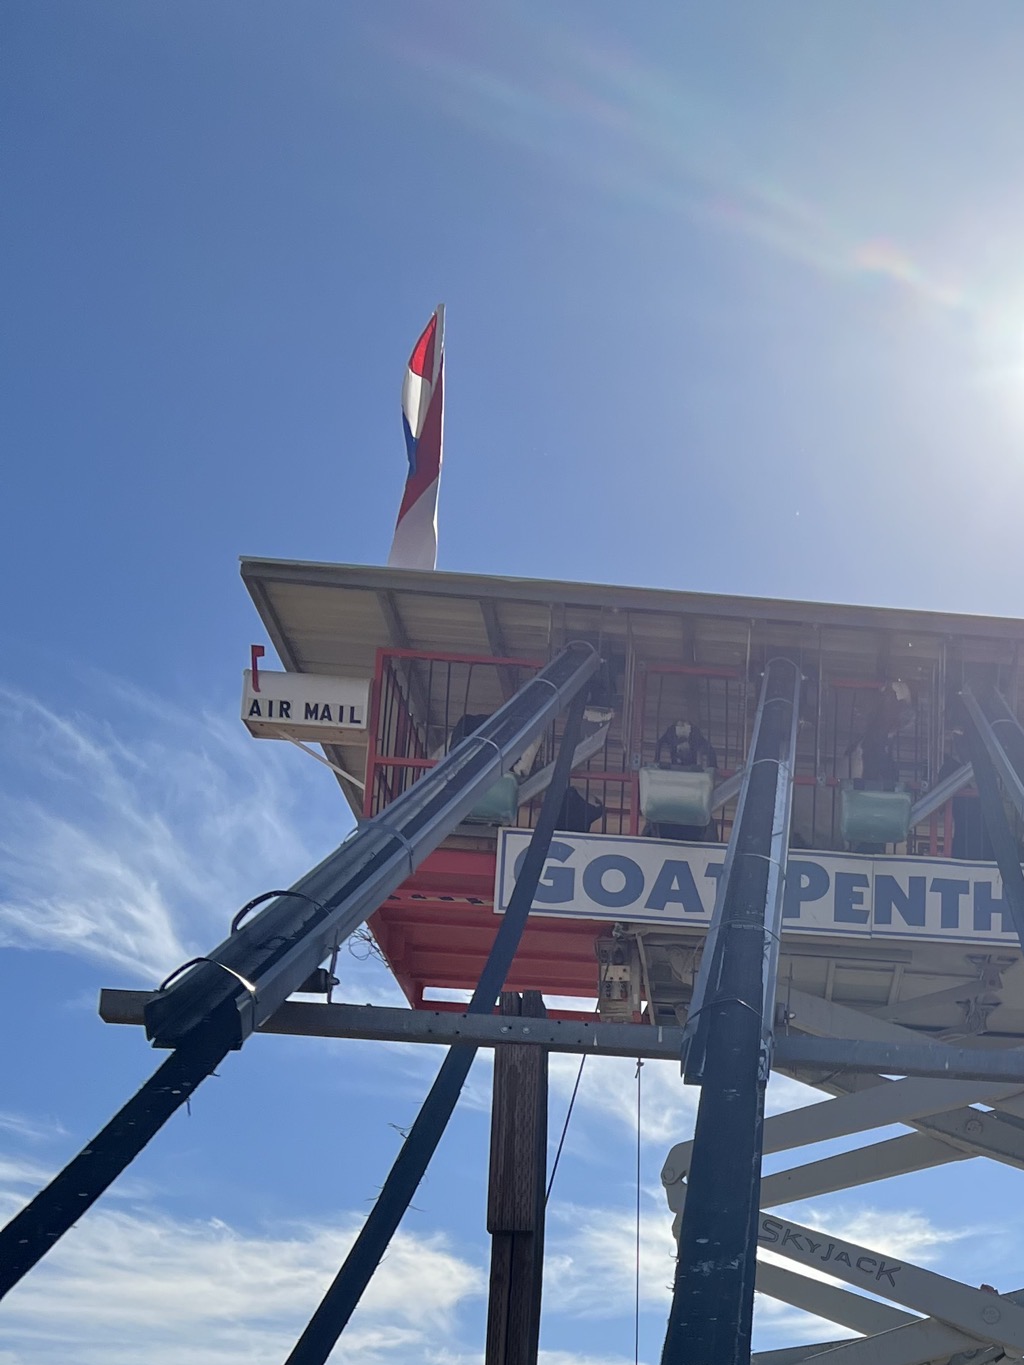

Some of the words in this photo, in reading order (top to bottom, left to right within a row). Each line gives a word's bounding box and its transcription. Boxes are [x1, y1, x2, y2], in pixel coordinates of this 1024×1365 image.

[249, 698, 291, 719] AIR
[304, 702, 362, 725] MAIL
[513, 840, 726, 913] GOA
[757, 1218, 902, 1289] SKYJACK
